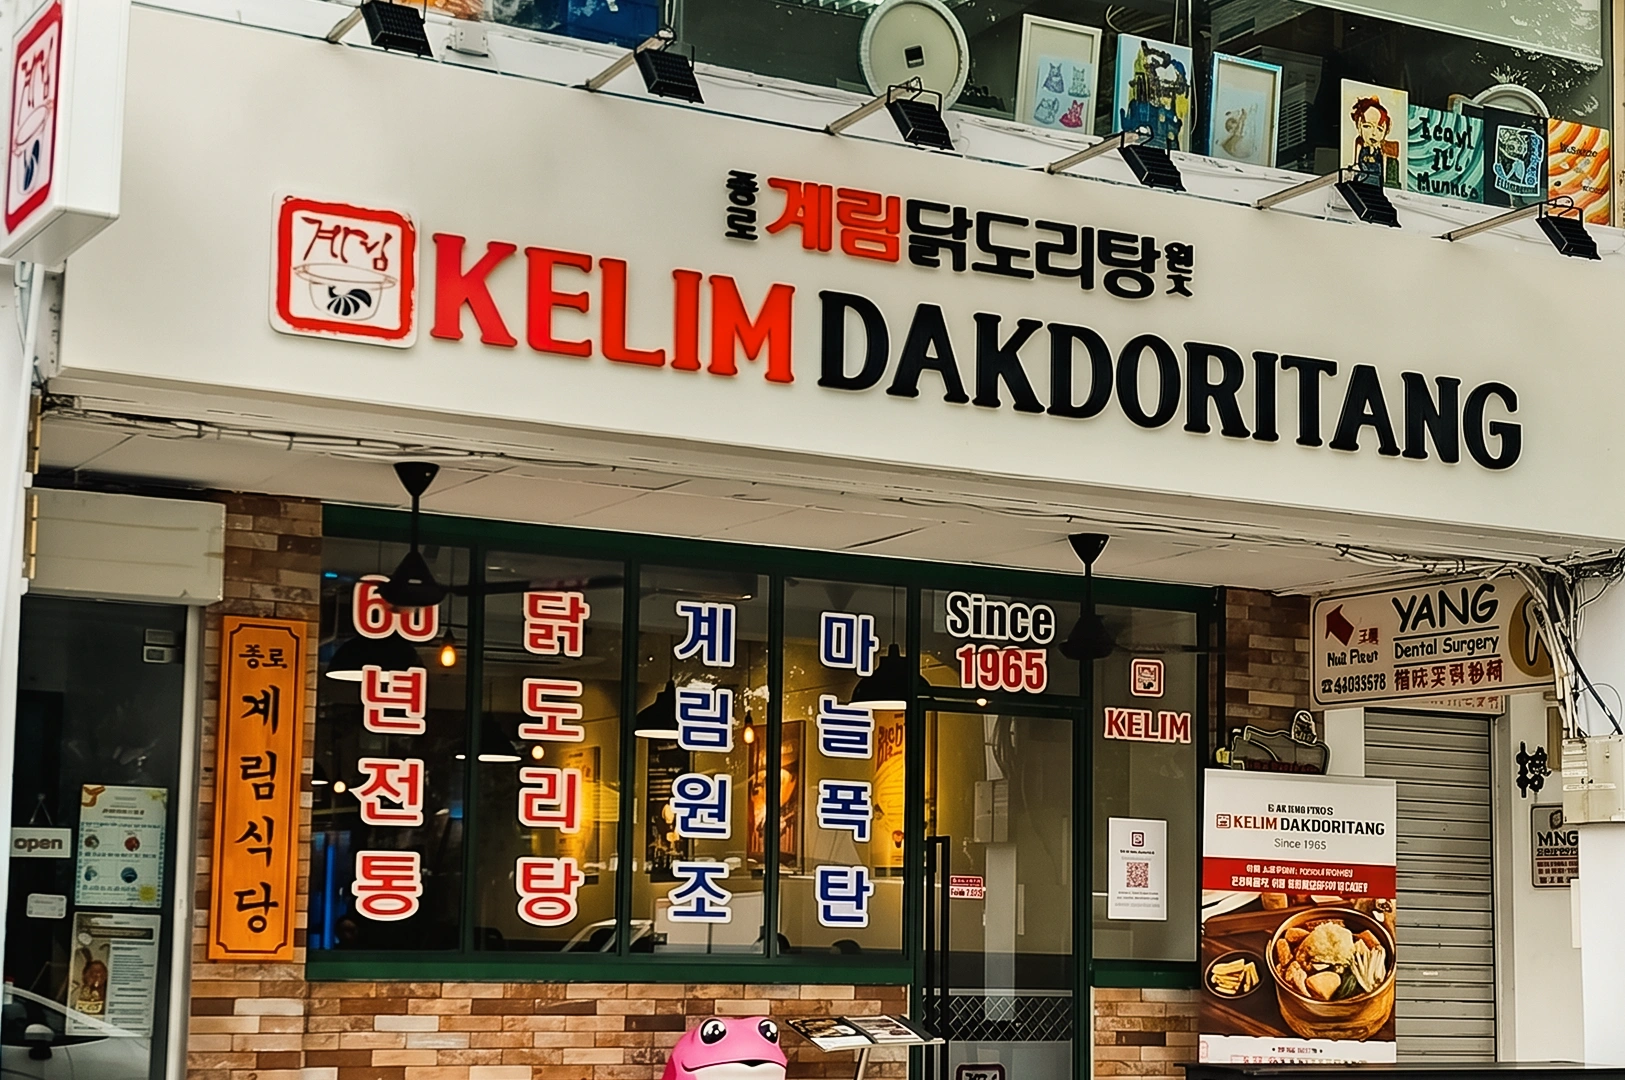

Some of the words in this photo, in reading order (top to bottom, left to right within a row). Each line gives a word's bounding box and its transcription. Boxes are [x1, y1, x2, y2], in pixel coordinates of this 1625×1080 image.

[430, 232, 796, 383] KELIM
[817, 289, 1522, 472] DAKDORITANG
[946, 591, 1055, 644] Since
[1391, 583, 1500, 633] YANG
[239, 645, 288, 669] 종로
[1394, 638, 1438, 659] Dental
[1443, 635, 1500, 656] Surgery
[956, 643, 1047, 693] 1965
[1104, 706, 1191, 744] KELIM
[233, 685, 281, 933] 계림식당
[1233, 815, 1278, 830] KELIM
[1280, 817, 1385, 835] DAKDORITANG
[14, 838, 63, 852] open
[1274, 838, 1301, 849] Since
